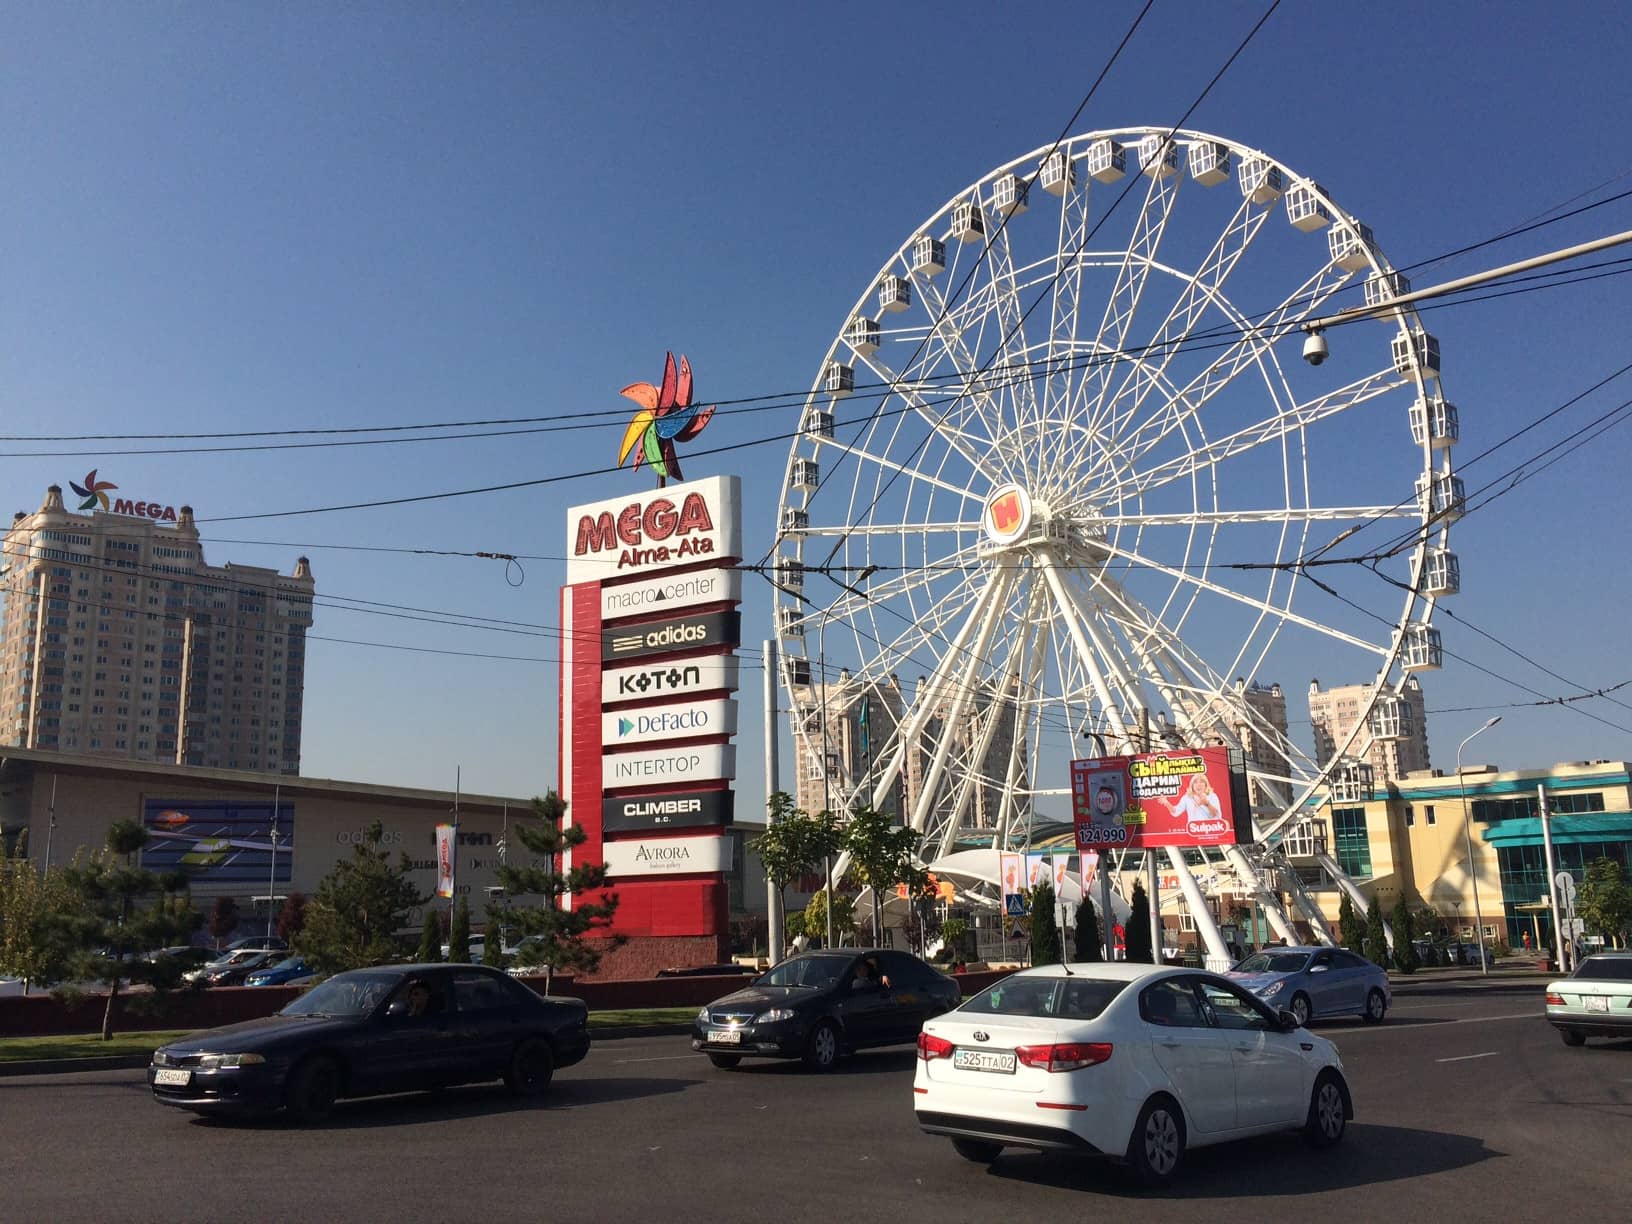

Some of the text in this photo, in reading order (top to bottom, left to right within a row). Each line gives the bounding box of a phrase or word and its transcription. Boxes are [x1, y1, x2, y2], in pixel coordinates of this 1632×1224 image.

[113, 498, 177, 521] MEGA
[574, 491, 714, 556] MEGA
[617, 536, 714, 569] Alma-Ata
[646, 624, 707, 647] adidas
[638, 708, 708, 734] DeFacto
[615, 756, 701, 778] INTERTOP
[1132, 786, 1177, 797] ПОДАРКИ
[1133, 775, 1180, 788] ДАРИМ
[623, 799, 701, 817] CLIMBER
[1189, 821, 1225, 834] Sulpak
[973, 1032, 990, 1042] KIA
